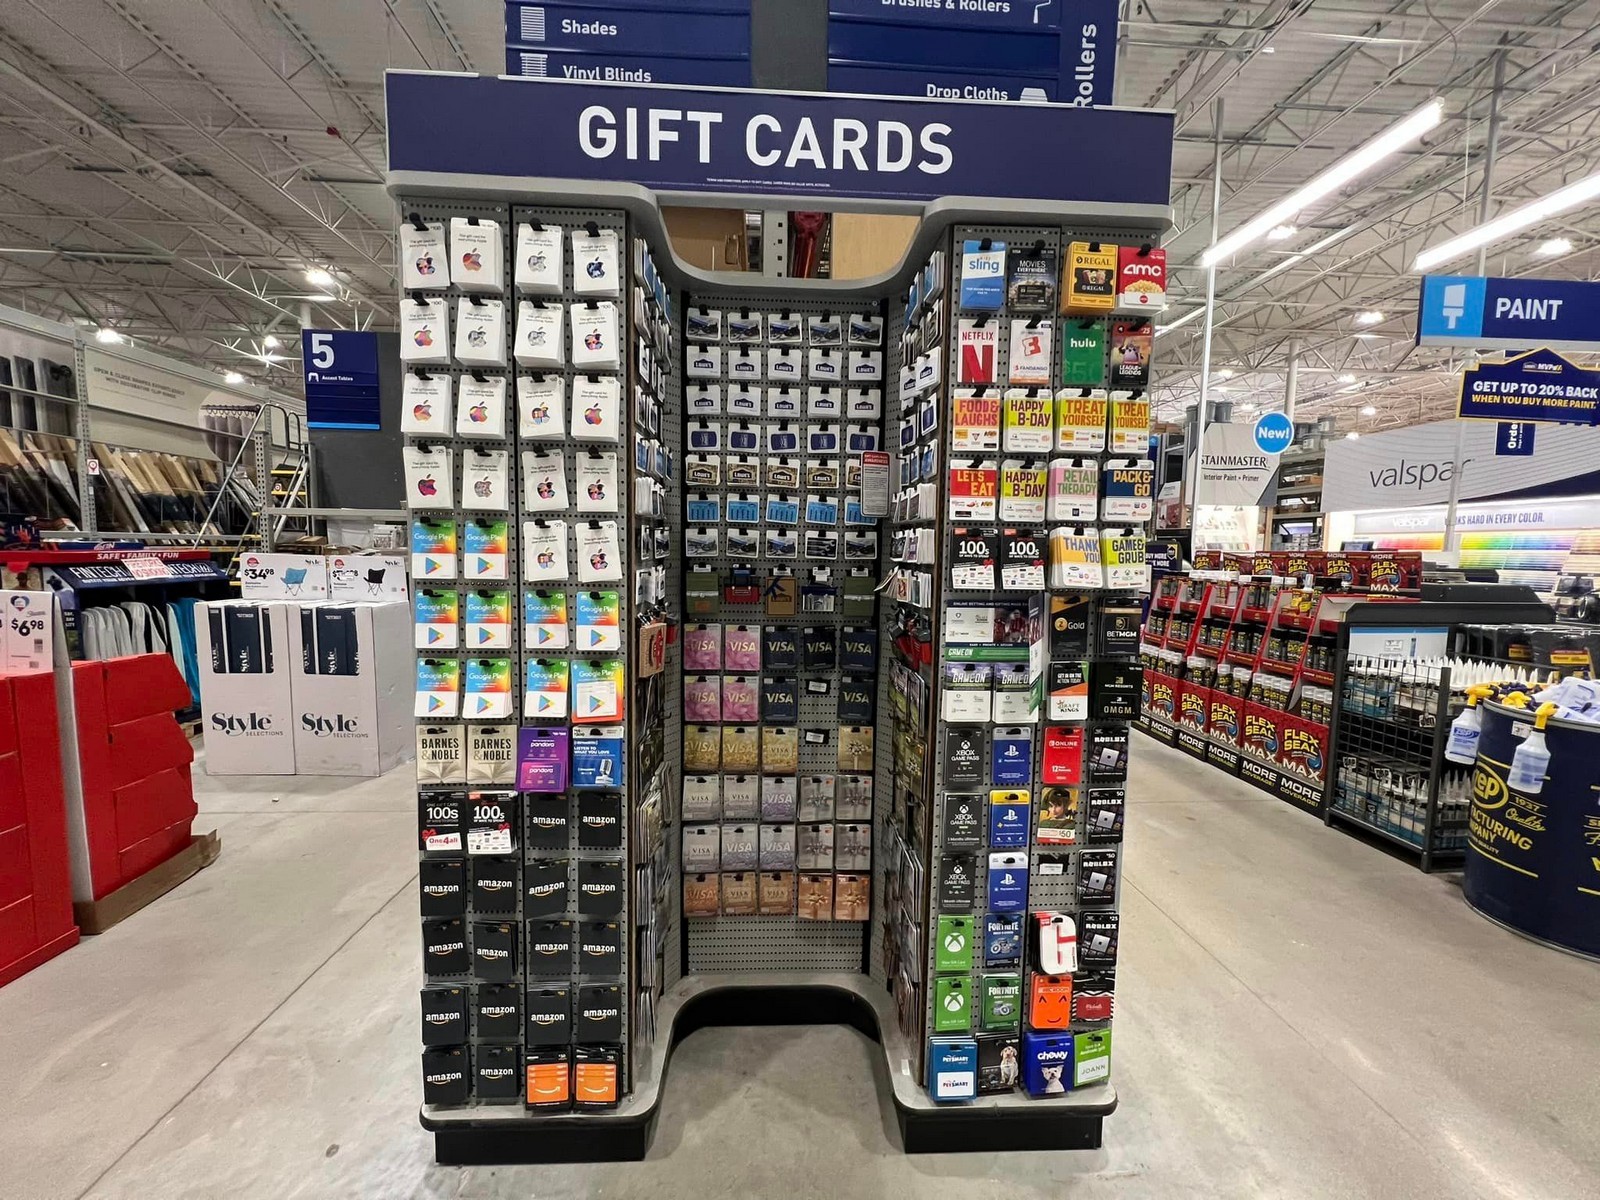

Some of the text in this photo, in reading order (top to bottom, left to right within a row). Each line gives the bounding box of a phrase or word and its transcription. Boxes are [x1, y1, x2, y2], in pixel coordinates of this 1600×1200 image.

[944, 0, 957, 11] &
[960, 0, 1011, 14] Rollers
[561, 19, 617, 37] Shades
[1073, 24, 1098, 108] Rollers
[563, 65, 652, 83] Vinyl Blinds
[927, 84, 1008, 101] Drop Cloths
[578, 105, 954, 175] GIFT CARDS
[969, 257, 1000, 274] sling
[1019, 260, 1046, 268] MOVIES
[1084, 257, 1112, 266] REGAL
[1123, 264, 1162, 276] amc
[1495, 297, 1563, 321] PAINT
[962, 331, 993, 341] NETFLIX
[1070, 338, 1096, 348] hulu
[311, 333, 334, 369] 5
[1473, 380, 1599, 399] GET UP TO 20% BACK
[1010, 400, 1044, 412] HAPPY
[1065, 400, 1106, 413] TREAT
[1471, 393, 1500, 404] WHEN
[1502, 395, 1520, 405] YOU
[1522, 396, 1542, 406] BUY
[1542, 397, 1568, 408] MORE
[1117, 402, 1149, 415] TREAT
[954, 413, 998, 426] LAUGHS
[1018, 412, 1051, 427] B-DAY
[1063, 413, 1106, 426] YOURSELF
[1115, 415, 1149, 428] YOURSELF
[1258, 426, 1290, 440] New!
[1201, 455, 1268, 468] STAINMASTER
[957, 471, 985, 482] LET'S
[1005, 471, 1039, 484] HAPPY
[1063, 470, 1097, 482] RETAIL
[1203, 473, 1260, 482] Interior Paint Primer
[1369, 458, 1473, 491] valspar
[970, 482, 994, 496] EAT
[1012, 484, 1045, 497] B-DAY
[1057, 482, 1097, 495] THERAPY
[1134, 483, 1151, 496] GO
[1467, 515, 1485, 525] HARD
[1486, 514, 1494, 524] IN
[1495, 513, 1517, 524] EVERY
[414, 532, 452, 542] Google Play
[467, 532, 506, 542] Google Play
[958, 540, 990, 556] 100s
[1063, 537, 1100, 551] THANK
[97, 552, 179, 560] SAFE FAMILY FUN
[1084, 551, 1100, 564] YOU
[1118, 552, 1144, 564] GRUB
[1288, 560, 1308, 568] FLEX
[1327, 560, 1351, 569] FLEX
[1371, 561, 1399, 572] FLEX
[1327, 566, 1351, 576] SEAL
[1371, 568, 1397, 580] SEAL
[1370, 583, 1399, 592] MAX
[468, 603, 506, 613] Google Play
[1067, 621, 1085, 630] Gold
[1106, 630, 1137, 638] BETMGM
[730, 641, 756, 652] VISA
[768, 641, 795, 652] VISA
[845, 641, 872, 654] VISA
[765, 693, 793, 704] VISA
[1181, 693, 1204, 707] FLEX
[1181, 701, 1203, 714] SEAL
[1211, 702, 1237, 718] FLEX
[211, 712, 272, 737] Style
[1180, 716, 1204, 733] MAX
[1211, 711, 1236, 725] SEAL
[1245, 715, 1277, 732] FLEX
[302, 713, 358, 738] Style
[333, 731, 369, 739] SELECTIONS
[1209, 728, 1237, 746] MAX
[1245, 725, 1276, 740] SEAL
[1284, 729, 1320, 749] FLEX
[421, 738, 459, 749] BARNES
[473, 738, 512, 749] BARNES
[1178, 732, 1205, 749] MORE
[1208, 743, 1238, 764] MORE
[1244, 742, 1277, 764] MAX
[1284, 740, 1319, 756] SEAL
[422, 750, 460, 760] & NOBLE
[483, 750, 512, 760] NOBLE
[1242, 760, 1277, 782] MORE
[1282, 758, 1321, 783] MAX
[1280, 777, 1322, 803] MORE
[1515, 796, 1540, 812] 1937
[426, 806, 459, 819] 100s
[582, 815, 616, 824] amazon
[1505, 807, 1547, 833] Quality
[726, 843, 753, 852] VISA
[424, 884, 459, 893] amazon
[477, 879, 513, 888] amazon
[535, 943, 569, 952] amazon
[481, 1005, 516, 1014] amazon
[942, 1055, 969, 1063] PETSMART
[1037, 1050, 1070, 1061] chewy
[427, 1071, 462, 1082] amazon
[1080, 1064, 1106, 1076] JOANN
